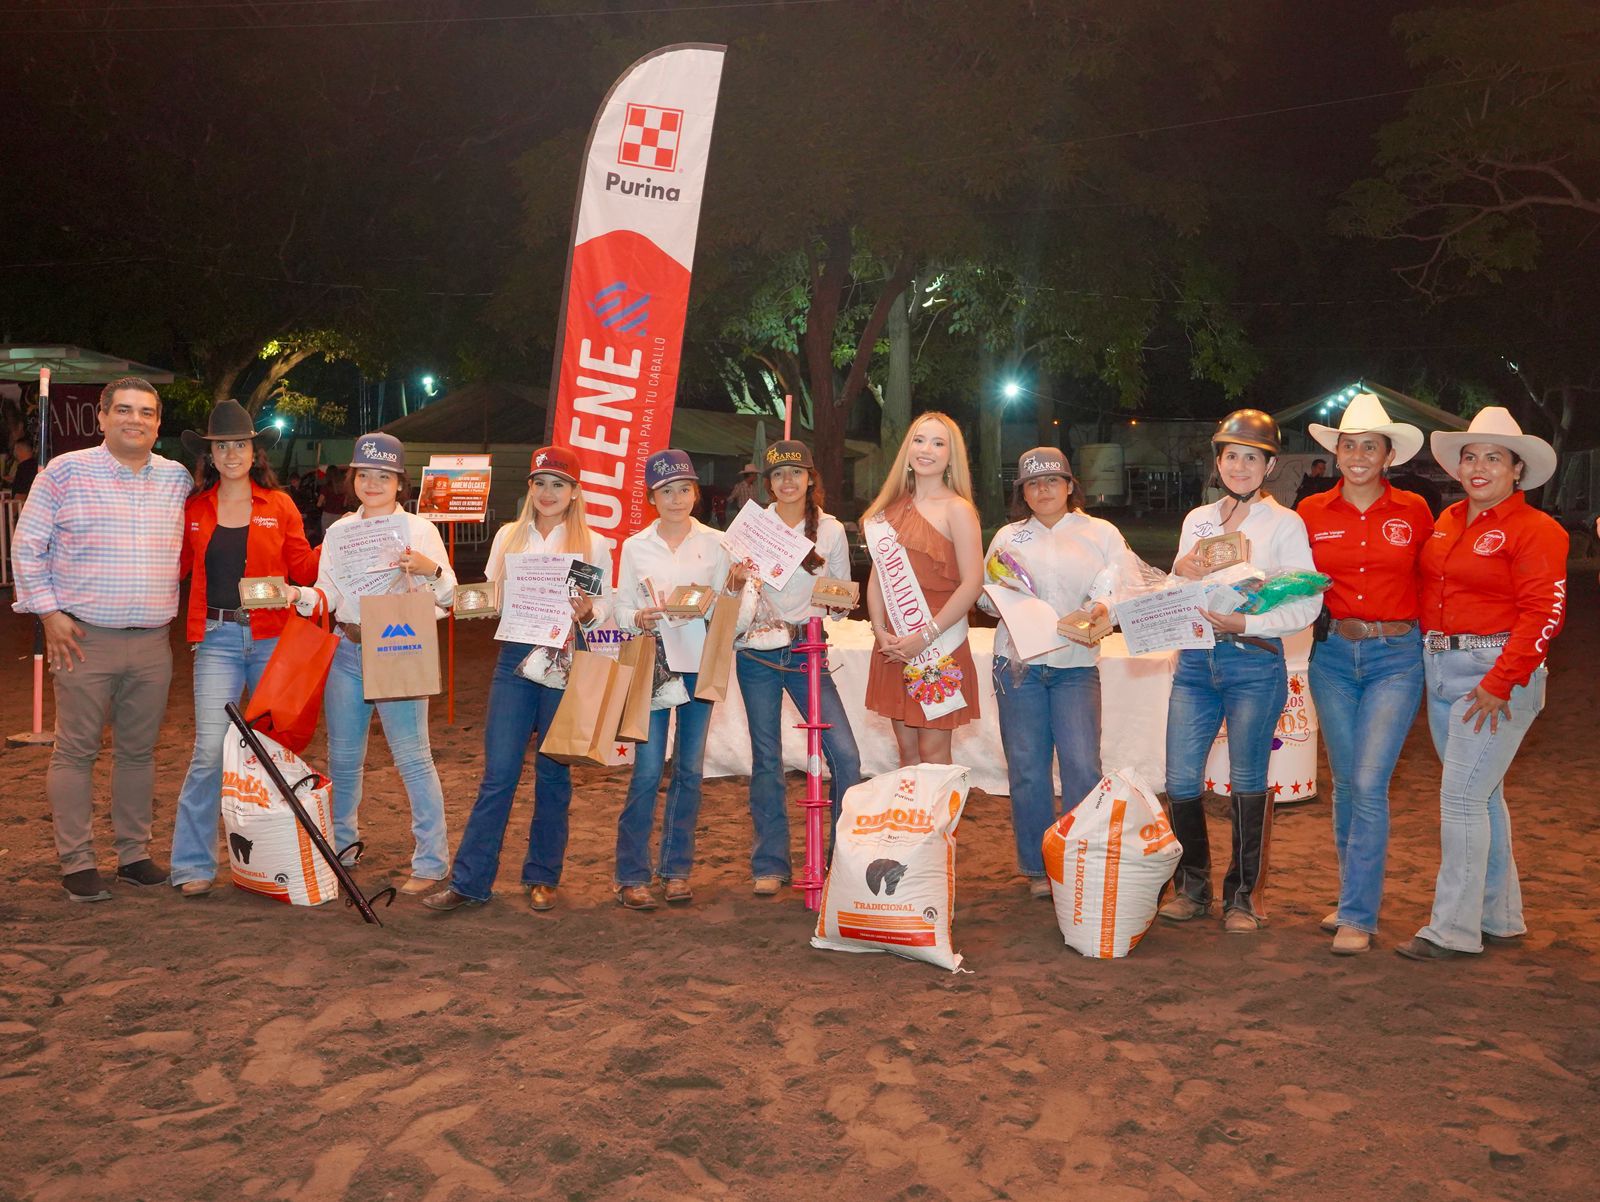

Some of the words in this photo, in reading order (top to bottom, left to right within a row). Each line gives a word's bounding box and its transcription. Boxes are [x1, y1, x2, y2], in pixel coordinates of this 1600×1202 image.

[606, 171, 681, 202] Purina
[648, 337, 666, 387] CABALLO
[645, 391, 657, 404] TU
[640, 408, 655, 437] PARA
[569, 338, 643, 550] OLENE
[370, 451, 397, 460] GARSO
[776, 452, 802, 460] GARSO
[664, 463, 689, 472] GARSO
[1034, 461, 1061, 470] GARSO
[629, 441, 650, 525] ESPECIALIZADA
[511, 603, 561, 615] RECONOCIMIENTO
[1131, 606, 1192, 625] RECONOCIMIENTO
[1535, 579, 1566, 653] COLIMA
[912, 647, 940, 666] 2025
[1073, 838, 1089, 926] TRADICIONAL
[853, 900, 915, 912] TRADICIONAL
